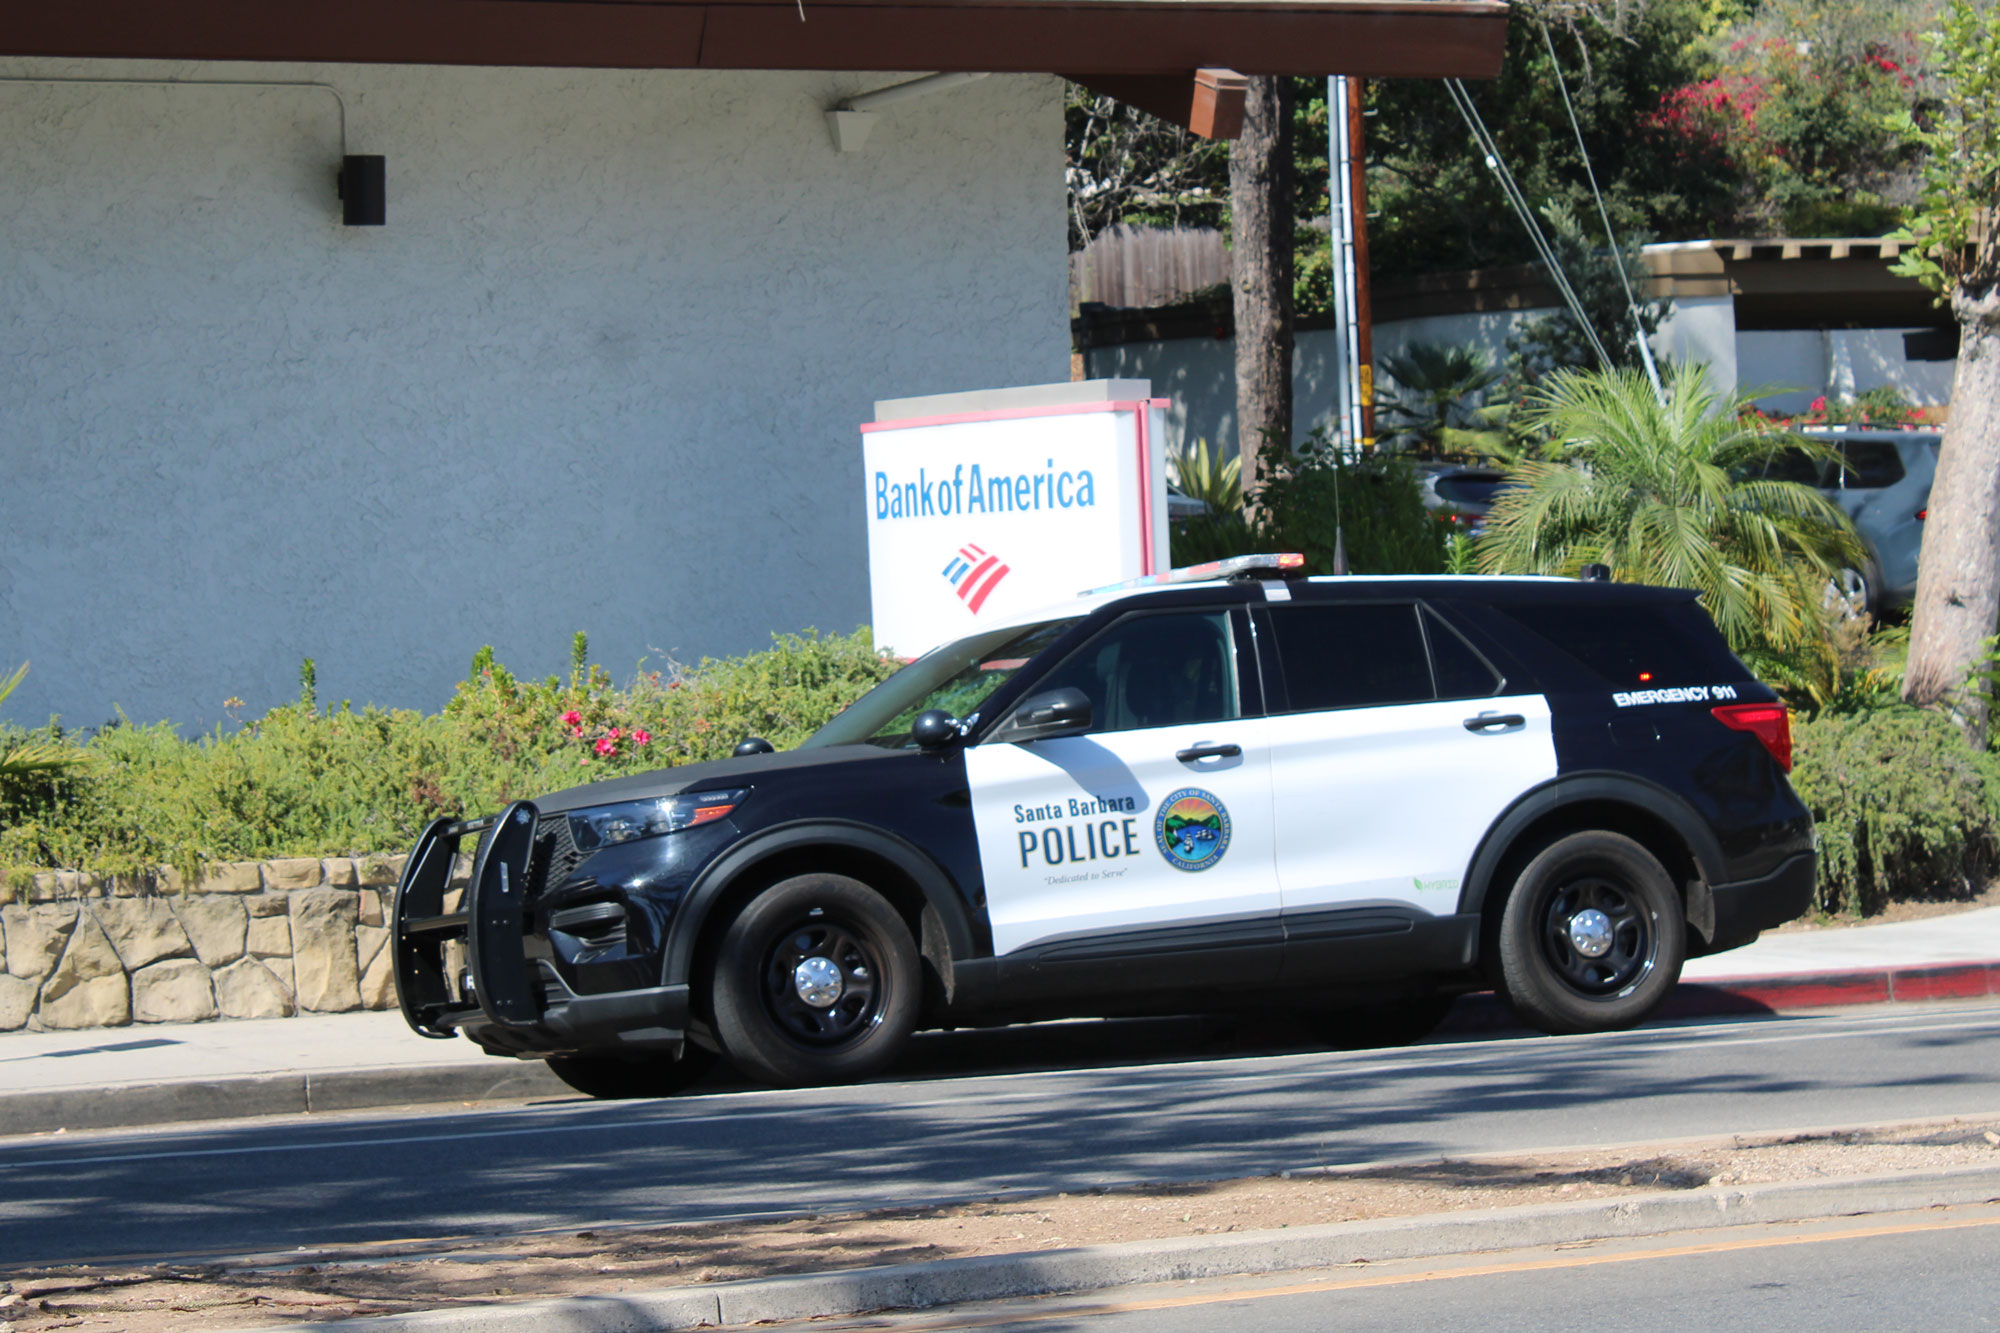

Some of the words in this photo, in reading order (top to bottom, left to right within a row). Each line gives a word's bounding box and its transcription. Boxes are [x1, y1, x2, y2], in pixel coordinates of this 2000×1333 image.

[875, 467, 935, 520] Bank
[938, 464, 963, 516] of
[967, 458, 1095, 514] America
[1612, 686, 1710, 708] EMERGENCY
[1711, 685, 1738, 700] 911
[1170, 790, 1187, 803] CITY
[1014, 804, 1063, 823] Santa
[1067, 796, 1136, 817] Barbara
[1019, 817, 1141, 868] POLICE
[1172, 855, 1219, 870] CALIFORNIA
[1090, 872, 1100, 880] to
